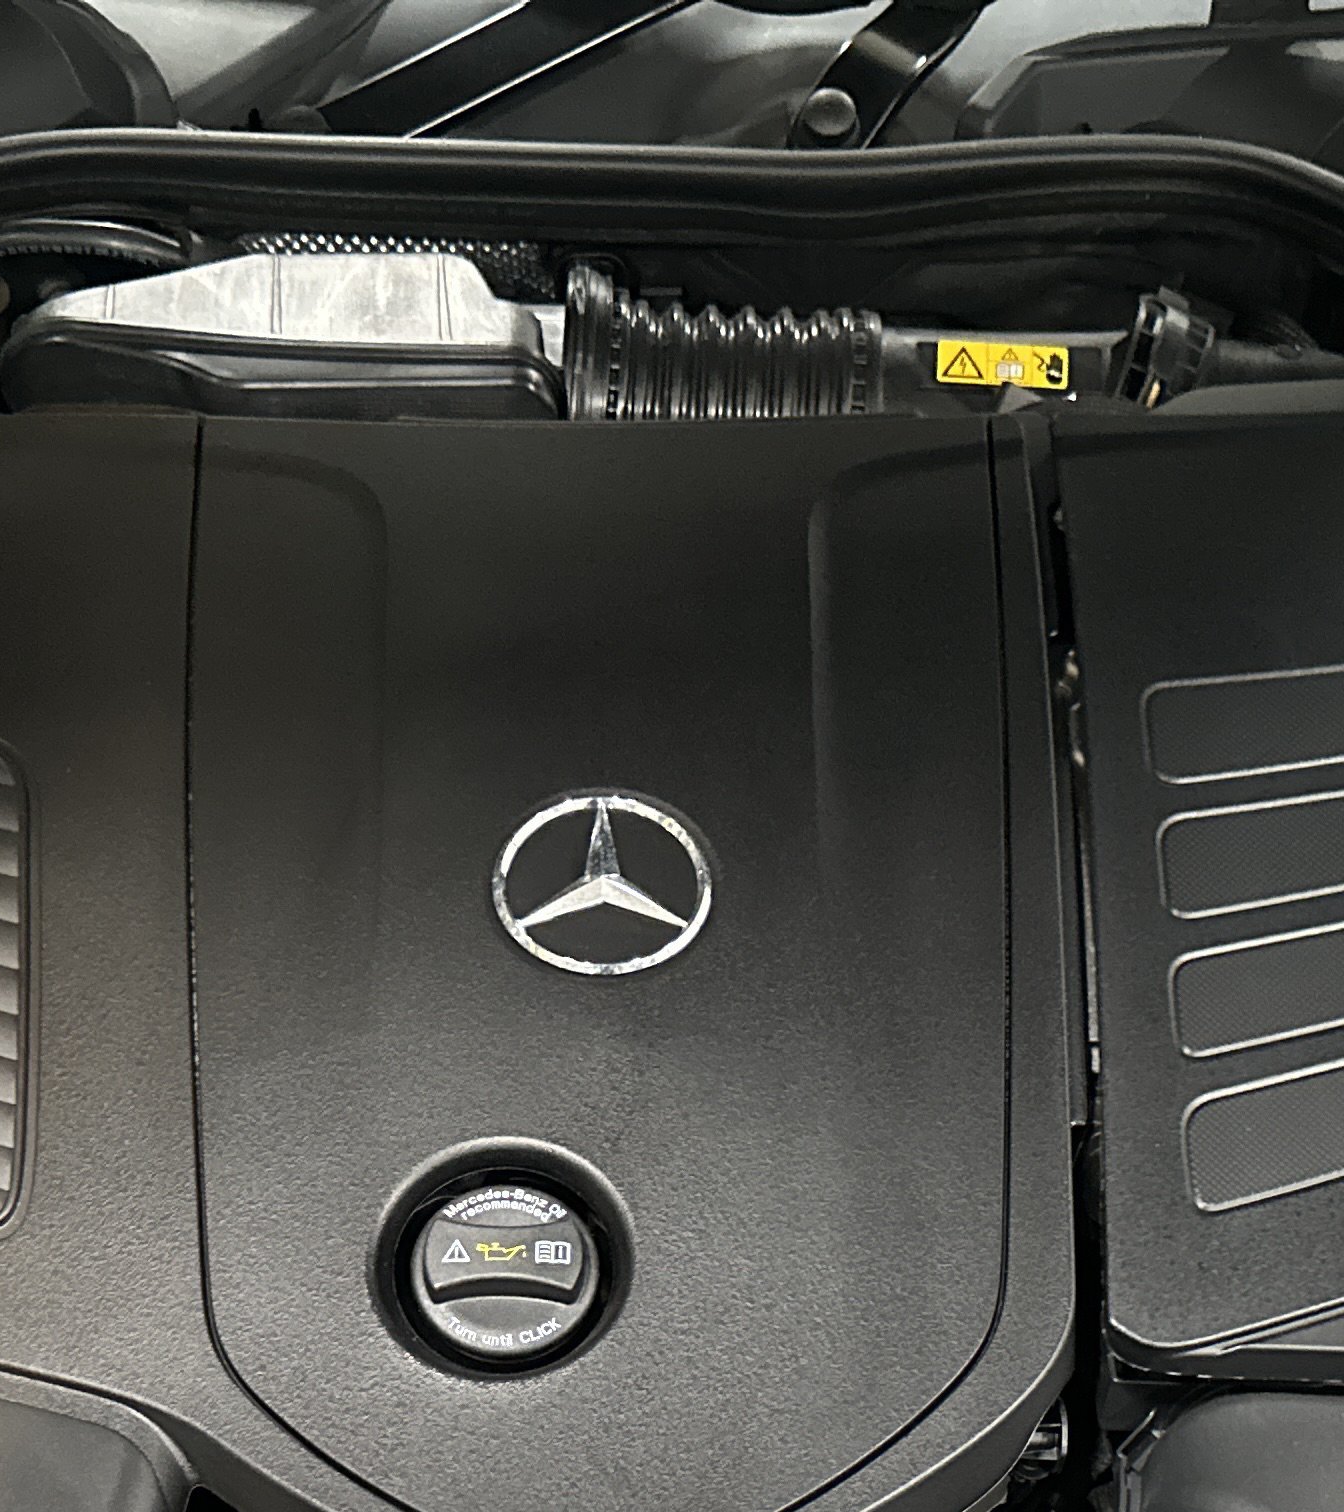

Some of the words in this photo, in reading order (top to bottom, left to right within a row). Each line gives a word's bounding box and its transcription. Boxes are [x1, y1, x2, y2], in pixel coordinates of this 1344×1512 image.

[442, 1188, 548, 1218] Mercedes-Benz
[548, 1203, 568, 1219] Oil
[460, 1200, 552, 1222] recommended
[448, 1316, 477, 1341] Turn
[482, 1333, 513, 1346] until
[519, 1317, 562, 1343] CLICK
